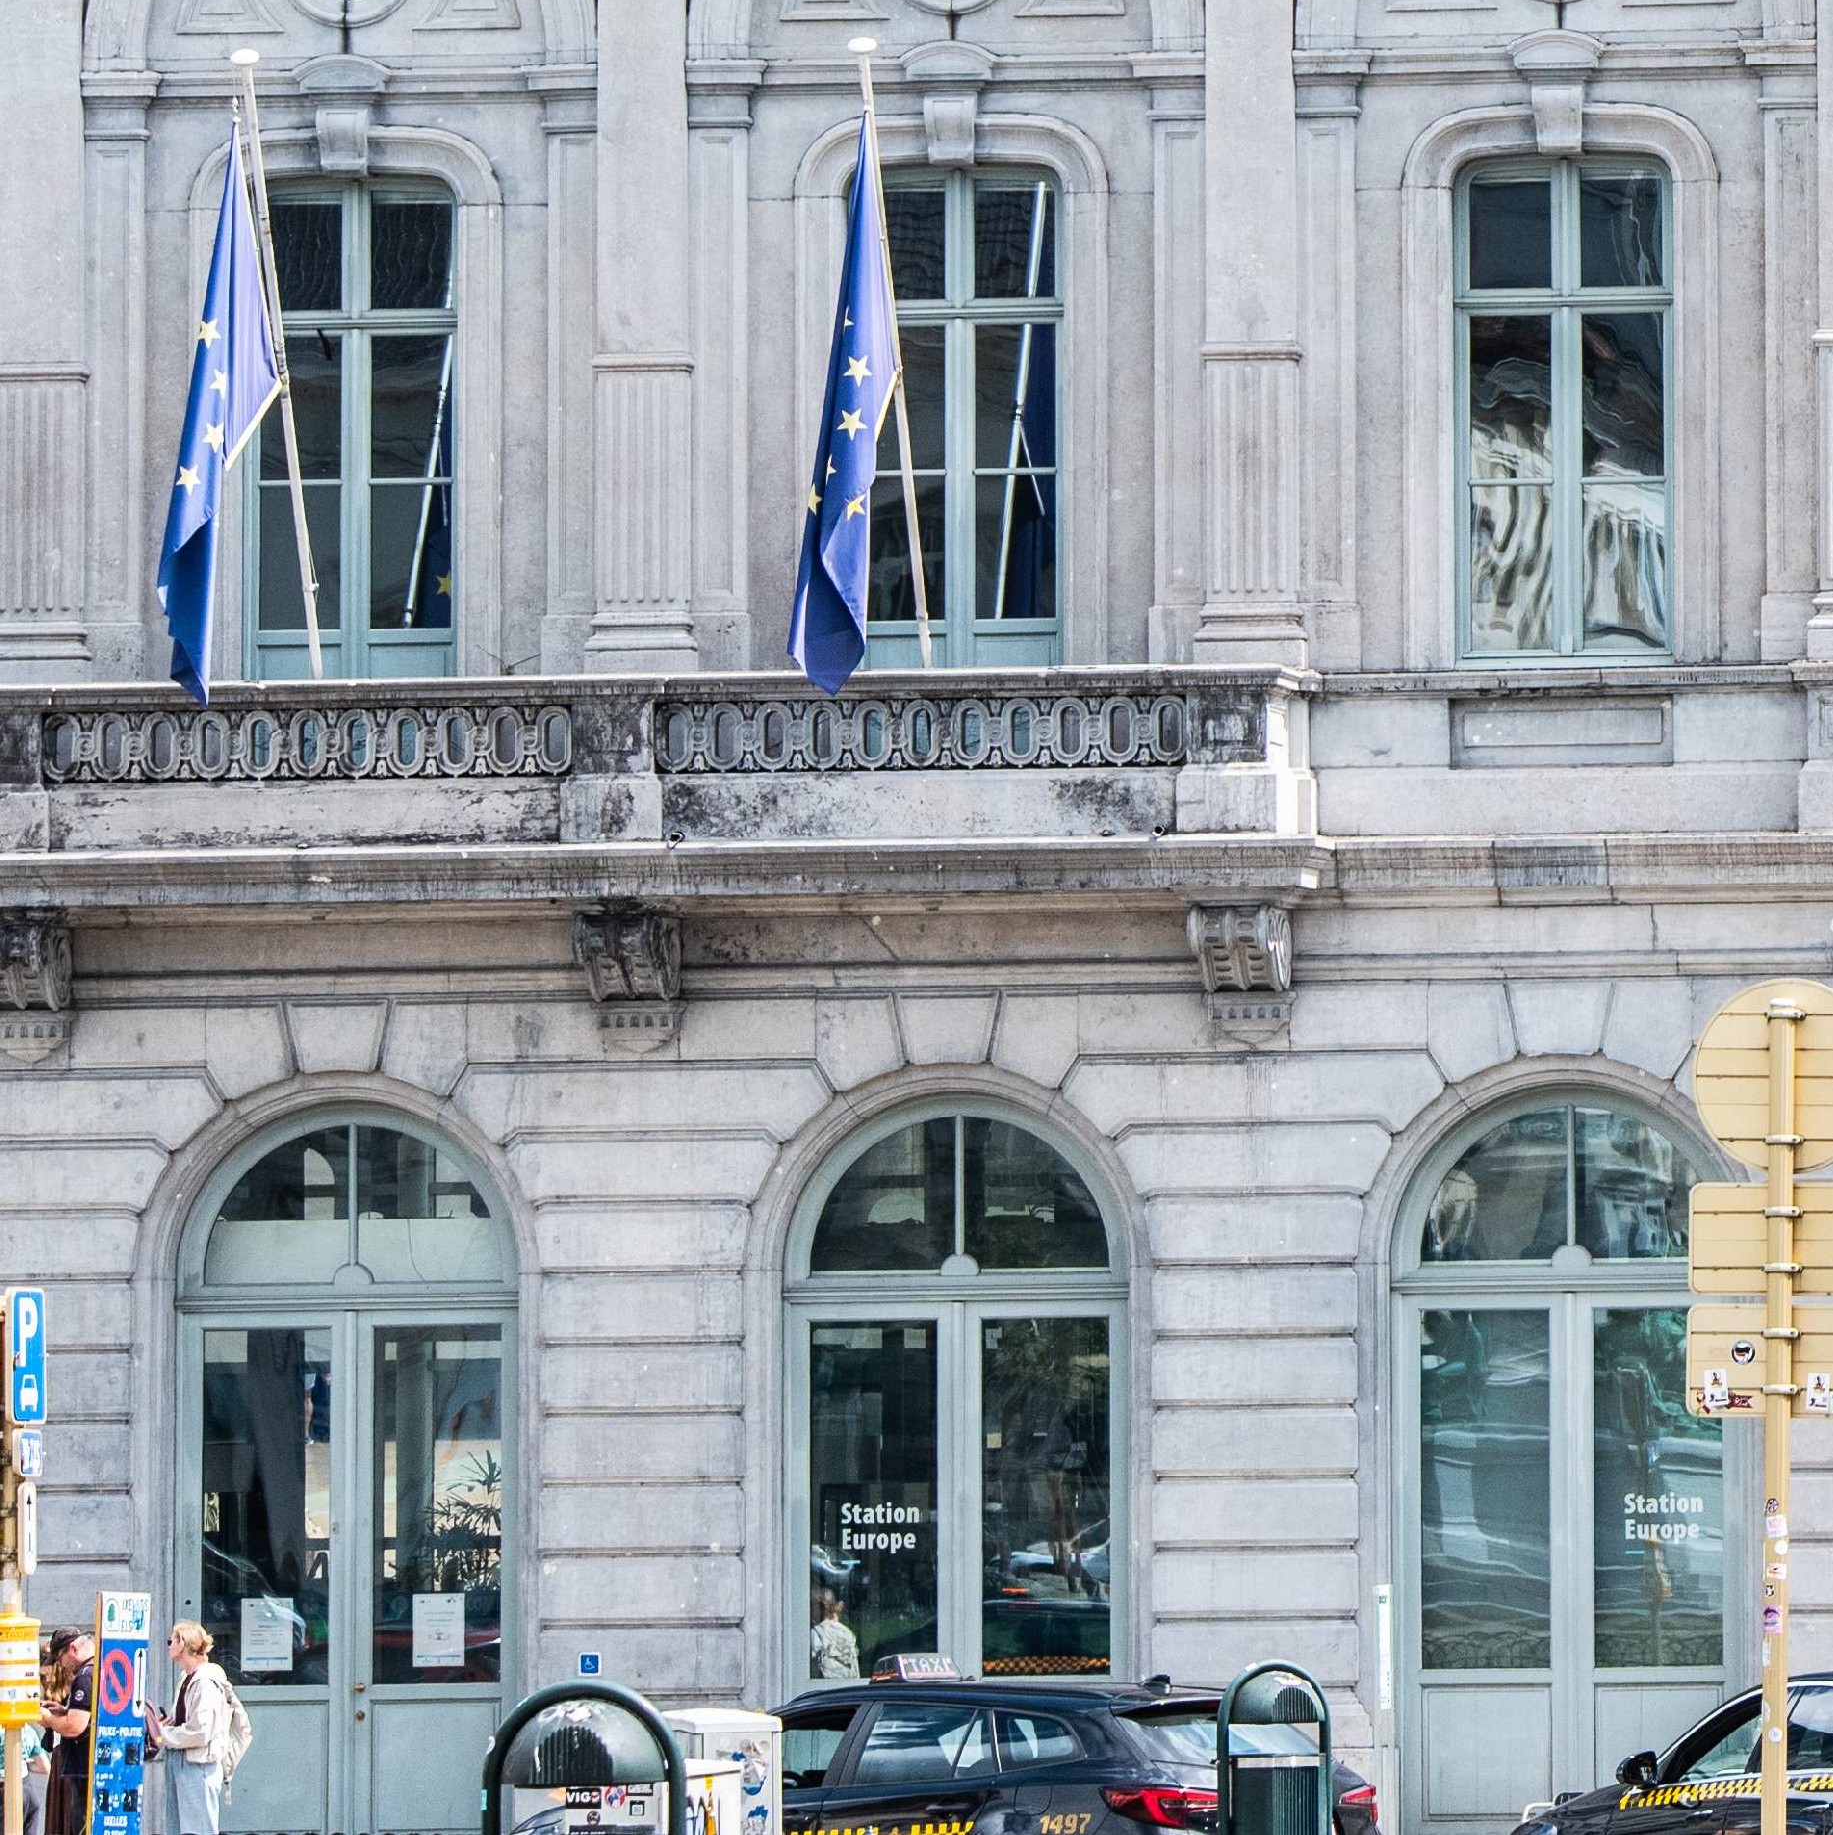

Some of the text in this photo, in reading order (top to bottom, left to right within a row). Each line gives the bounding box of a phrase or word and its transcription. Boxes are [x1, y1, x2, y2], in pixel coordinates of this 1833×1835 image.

[15, 1296, 38, 1367] P
[841, 1501, 920, 1524] Station
[1623, 1491, 1704, 1514] Station
[841, 1528, 917, 1554] Europe
[1624, 1518, 1700, 1545] Europe
[1039, 1813, 1092, 1835] 1497
